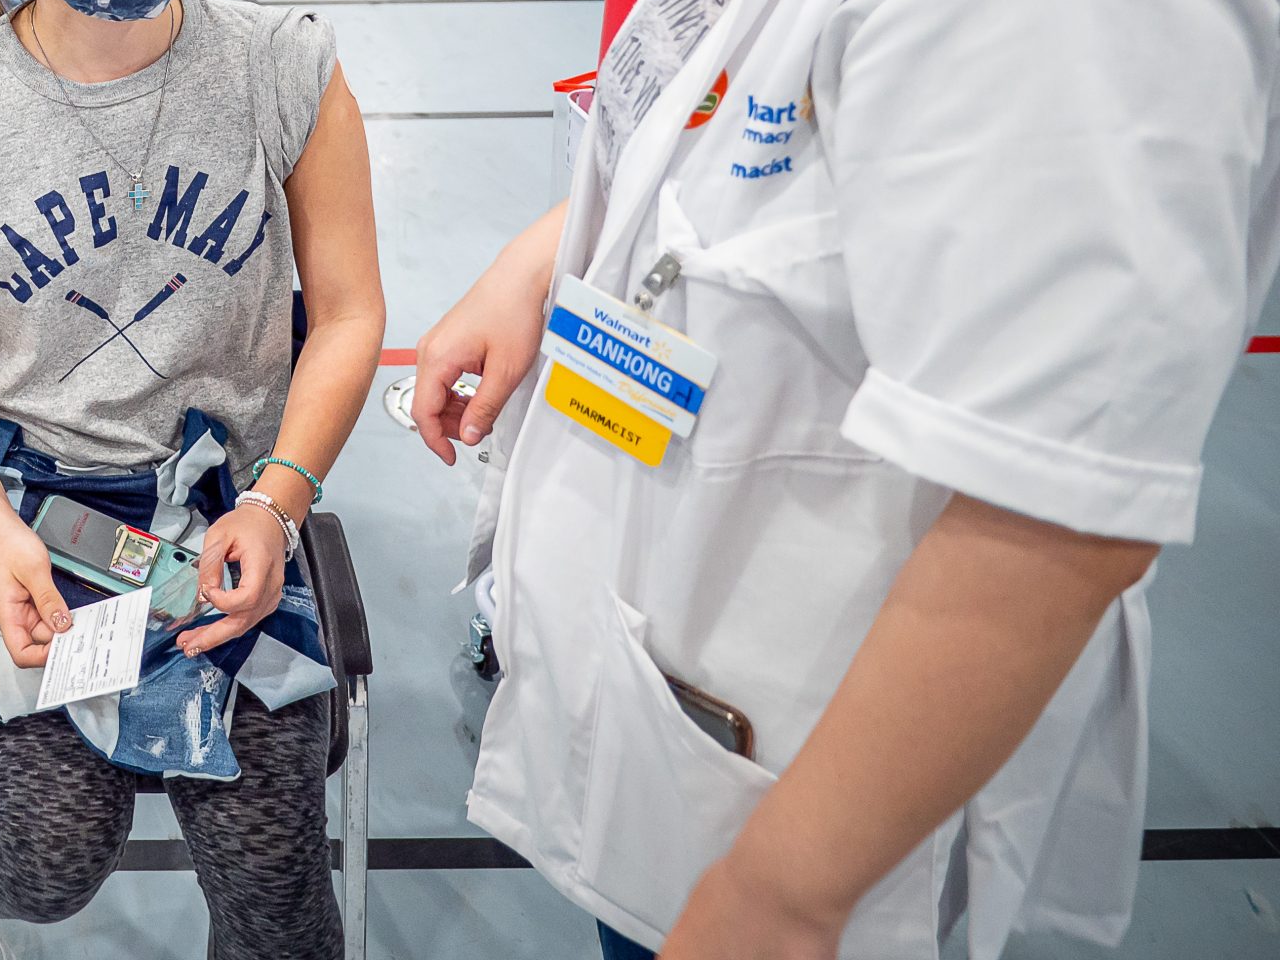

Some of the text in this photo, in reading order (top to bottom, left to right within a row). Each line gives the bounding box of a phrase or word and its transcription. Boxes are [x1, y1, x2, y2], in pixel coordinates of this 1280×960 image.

[731, 156, 793, 178] macist
[593, 306, 652, 349] Walmart
[576, 323, 673, 394] DANHONG
[569, 398, 642, 446] PHARMACIST
